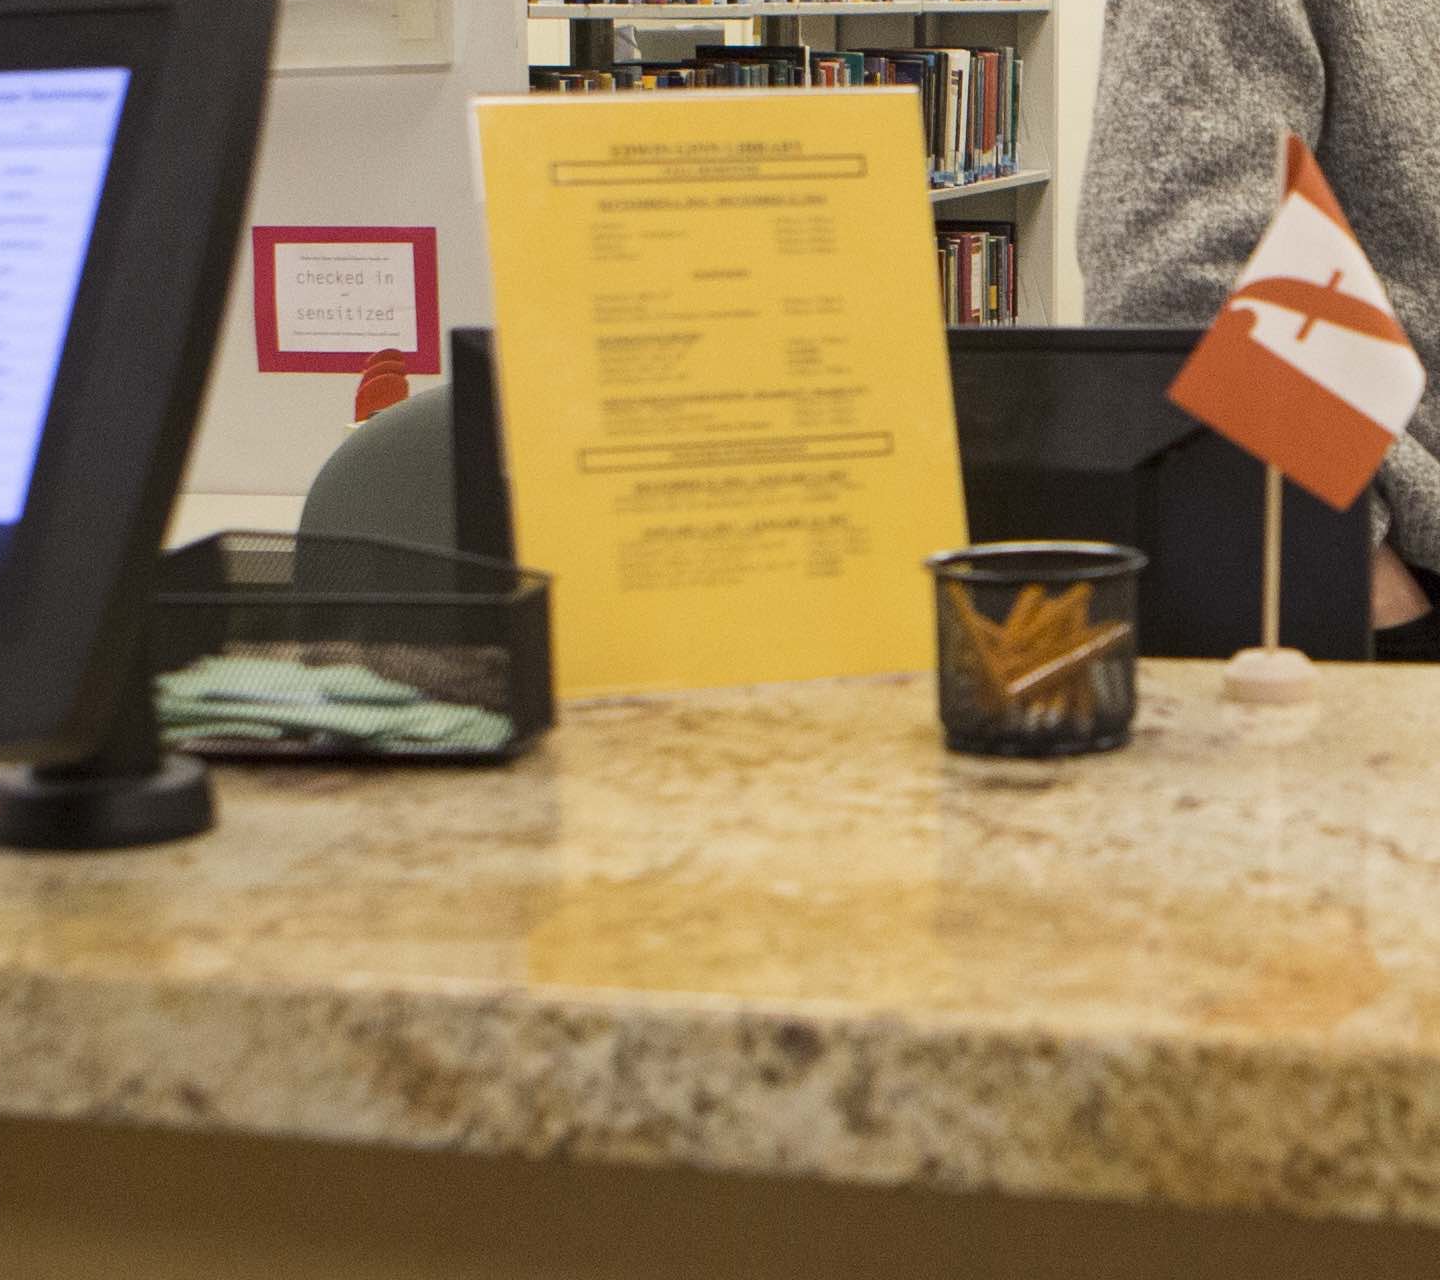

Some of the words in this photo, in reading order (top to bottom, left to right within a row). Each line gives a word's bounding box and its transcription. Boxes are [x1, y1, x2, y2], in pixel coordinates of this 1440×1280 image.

[296, 270, 364, 285] checked
[376, 271, 394, 285] in
[297, 306, 394, 321] sensitized
